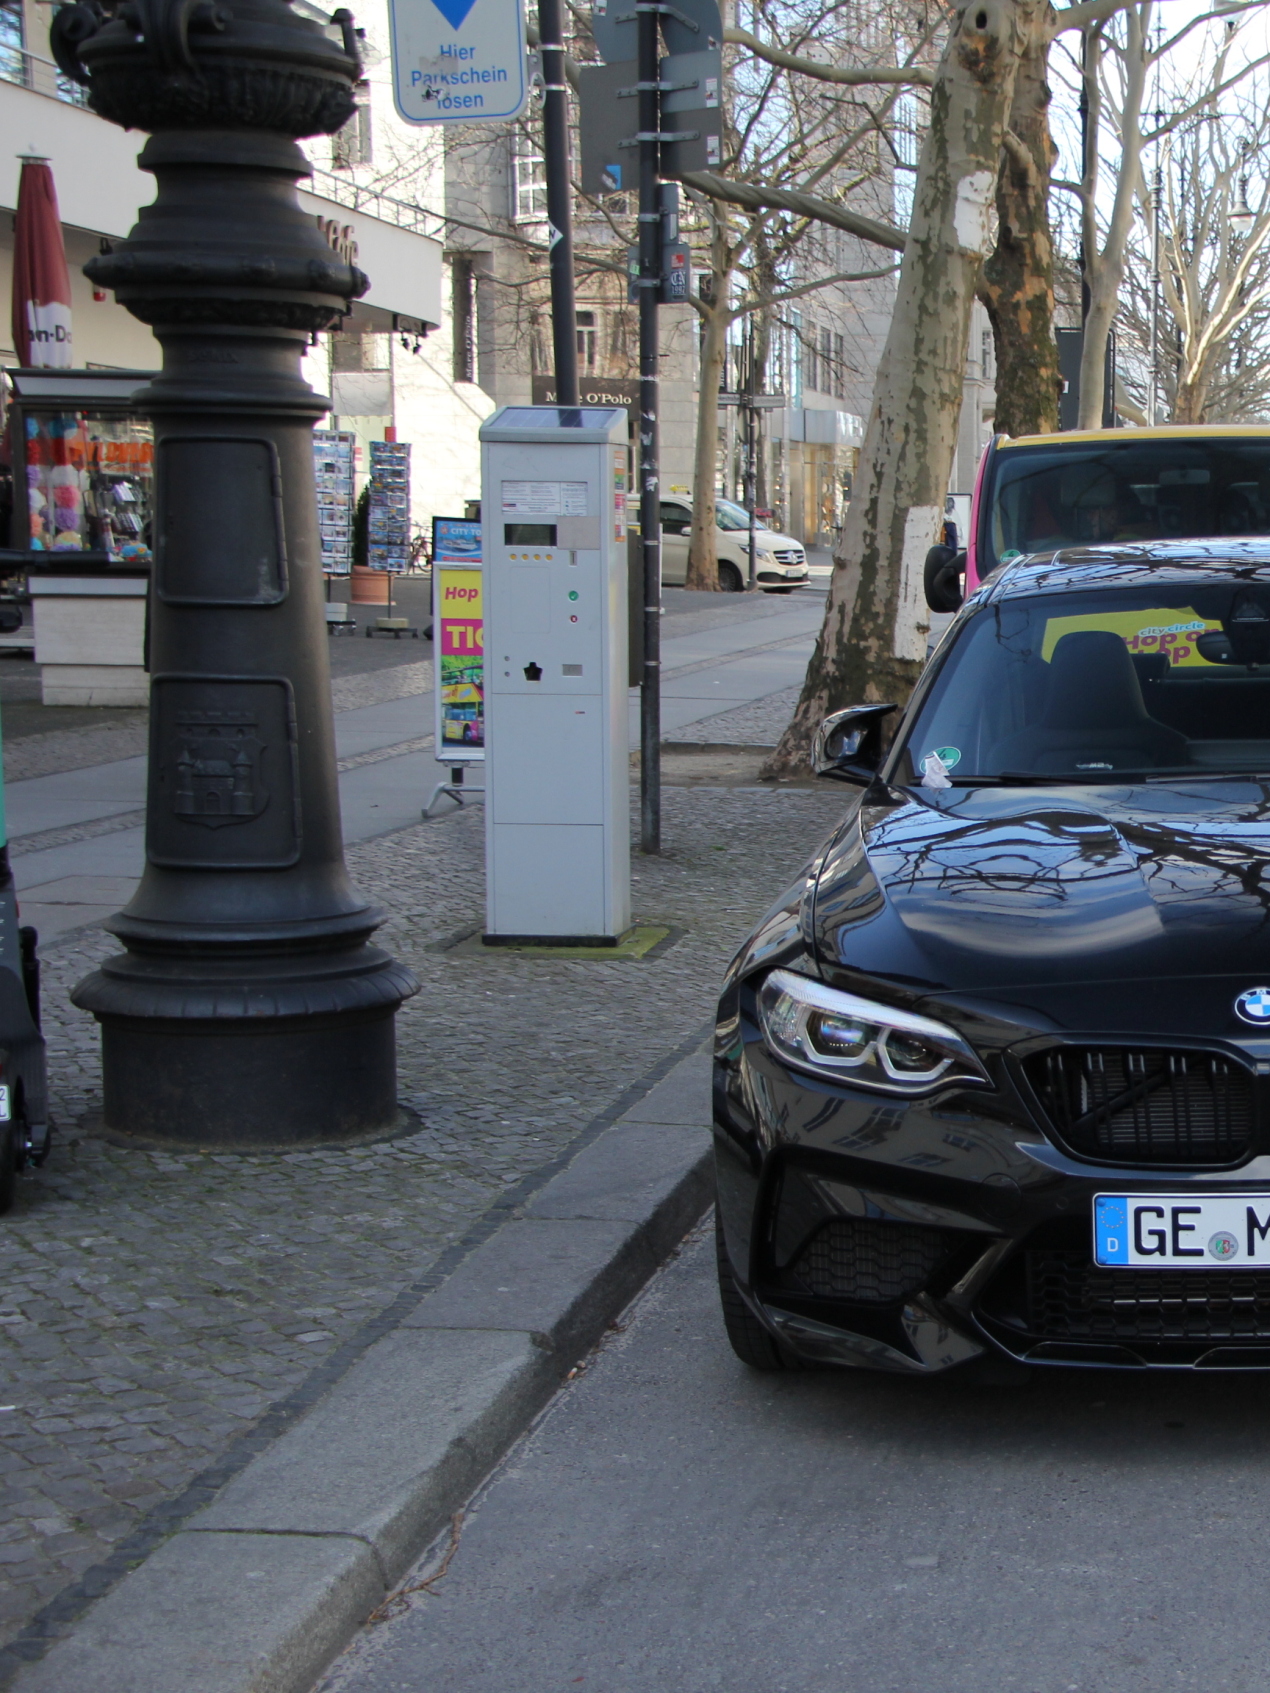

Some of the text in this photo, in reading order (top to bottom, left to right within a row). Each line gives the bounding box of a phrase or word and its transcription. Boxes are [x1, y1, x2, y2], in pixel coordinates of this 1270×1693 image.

[440, 44, 476, 60] Hier
[411, 65, 508, 87] Parkschein
[586, 393, 632, 405] O'Polo
[445, 586, 479, 602] Hop
[1140, 621, 1205, 636] city circle
[1133, 1205, 1205, 1257] GE
[1106, 1237, 1119, 1252] D
